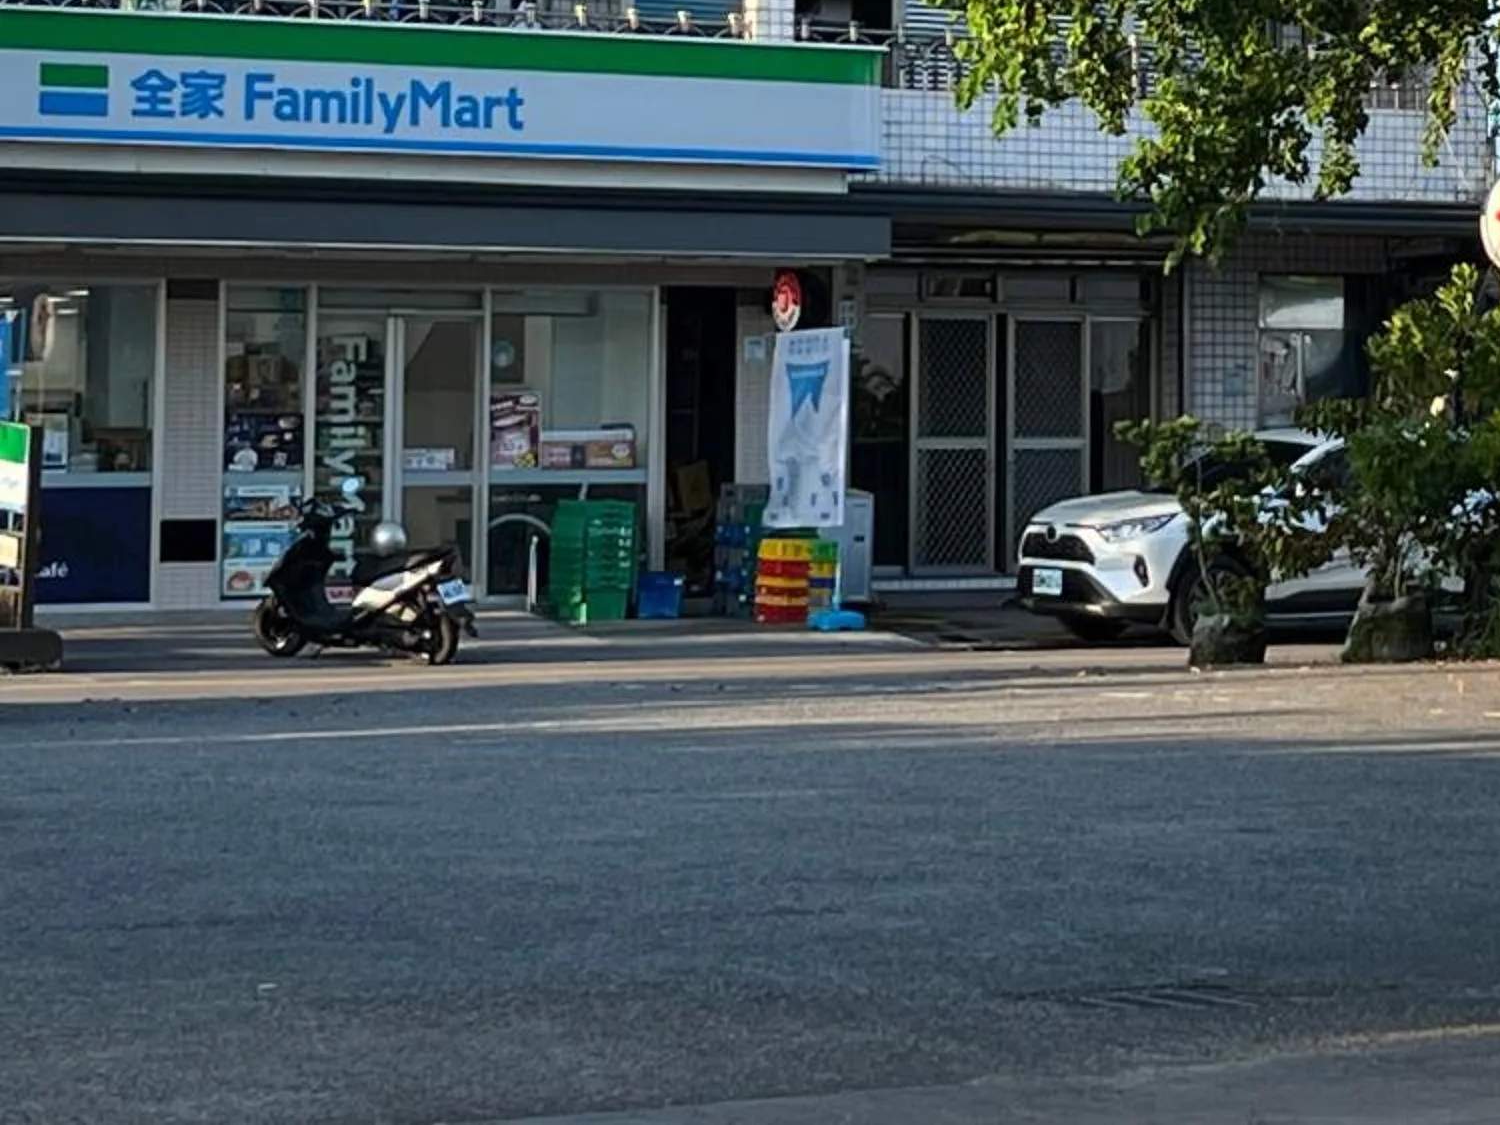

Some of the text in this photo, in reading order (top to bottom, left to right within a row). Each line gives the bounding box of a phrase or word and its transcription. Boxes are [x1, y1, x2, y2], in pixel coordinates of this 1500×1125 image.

[130, 68, 525, 134] 全家 FamilyMart
[323, 336, 369, 577] FamilyMart
[34, 560, 70, 578] afé
